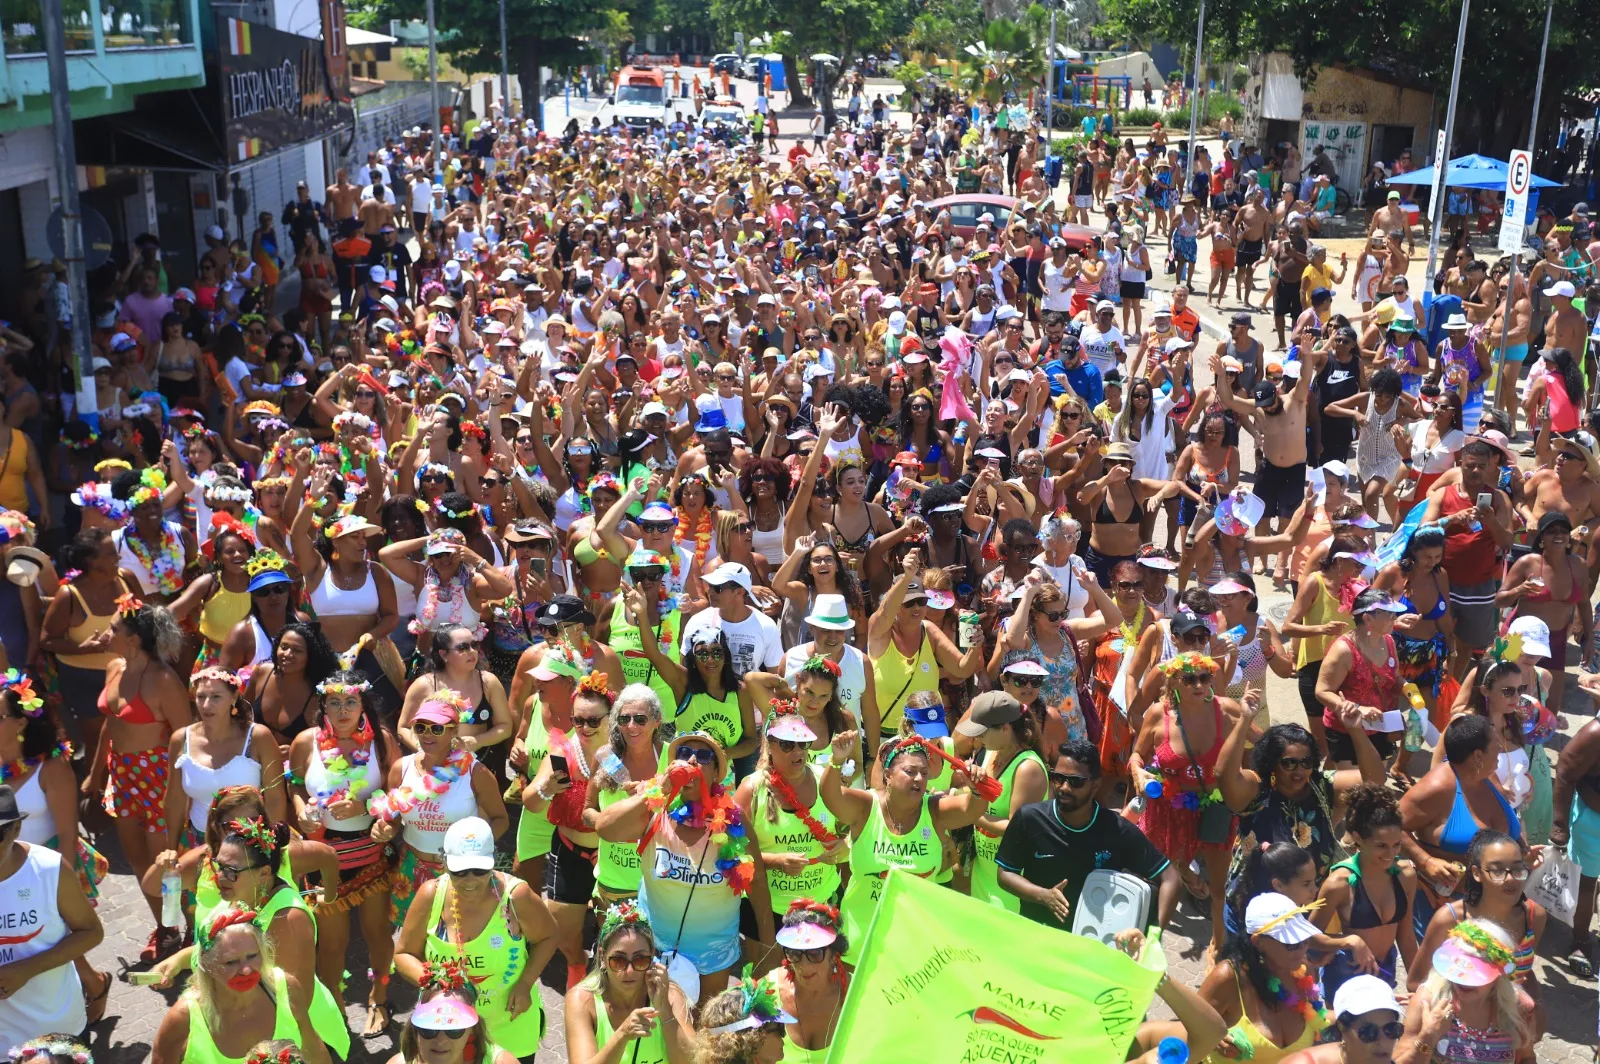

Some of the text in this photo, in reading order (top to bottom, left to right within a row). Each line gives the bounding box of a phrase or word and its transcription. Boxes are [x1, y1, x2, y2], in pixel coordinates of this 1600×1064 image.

[329, 1, 342, 56] H
[229, 58, 300, 119] HESPANHOL
[1515, 162, 1524, 186] E
[1086, 344, 1110, 354] BRAZI
[1332, 369, 1350, 379] NIKE
[841, 688, 852, 700] AS
[419, 812, 445, 820] você
[775, 832, 818, 845] MAM
[787, 845, 812, 853] PASSOU
[873, 840, 929, 857] MAMÃE
[609, 853, 642, 868] AGUEN
[804, 867, 824, 879] QUEM
[771, 877, 822, 891] AGUENTA
[0, 909, 38, 929] IE AS
[983, 981, 1066, 1021] MAMÃE
[979, 1029, 1006, 1046] FICA
[1008, 1038, 1045, 1057] QUEM
